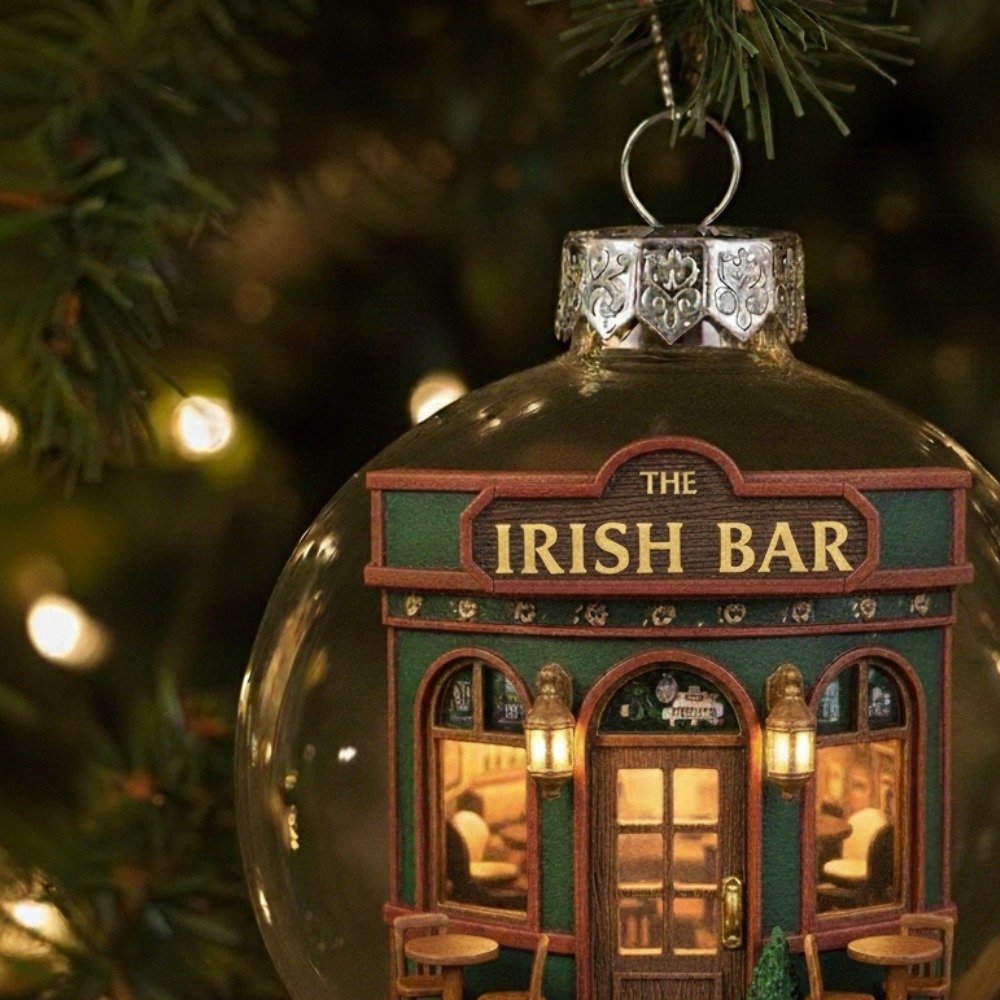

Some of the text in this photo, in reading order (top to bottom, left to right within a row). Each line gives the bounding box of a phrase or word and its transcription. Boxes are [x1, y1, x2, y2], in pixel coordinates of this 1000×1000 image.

[640, 471, 697, 495] THE
[495, 521, 853, 575] IRISH BAR
